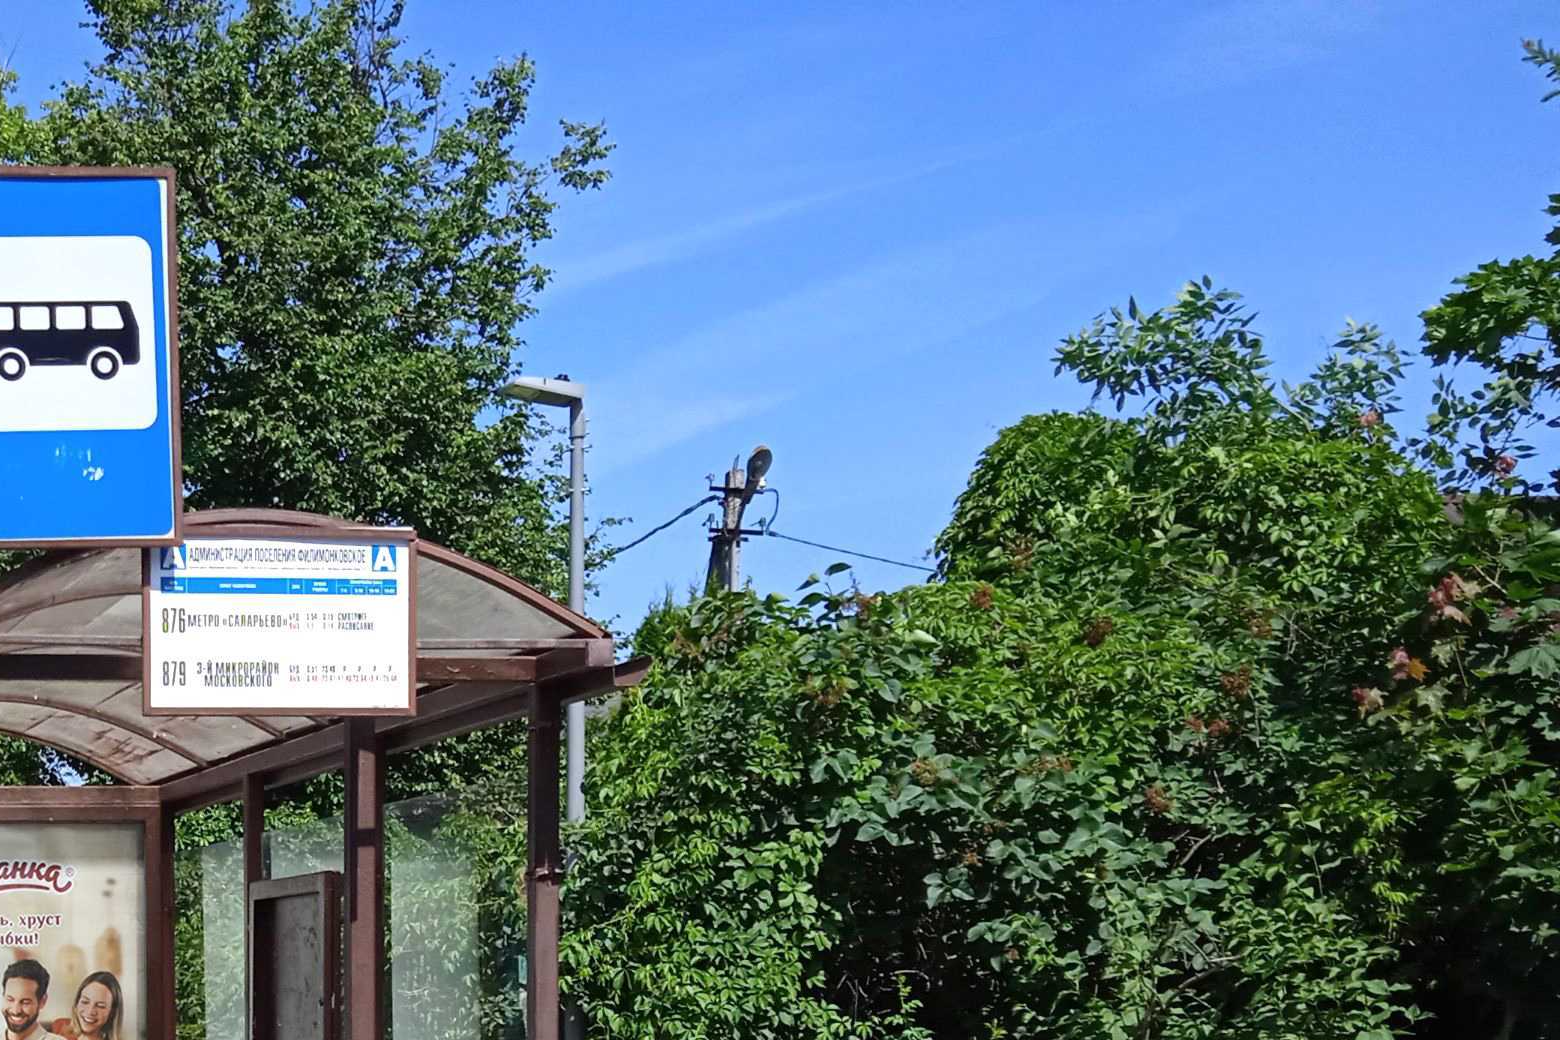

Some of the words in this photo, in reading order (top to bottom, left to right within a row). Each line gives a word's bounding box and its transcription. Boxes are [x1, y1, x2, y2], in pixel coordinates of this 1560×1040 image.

[189, 547, 253, 564] АДМИНИСТРАЦИЯ
[254, 548, 296, 563] ПОСЕЛЕНИЯ
[297, 548, 366, 564] ФИЛИМОНКОВСКОЕ
[161, 607, 186, 634] 876
[187, 614, 220, 628] МЕТРО
[162, 661, 186, 687] 879
[196, 659, 213, 675] 3-Й
[215, 660, 280, 676] МИКРОРАЙОН
[204, 674, 273, 687] МОСКОВСКОГО
[19, 914, 62, 930] хруст
